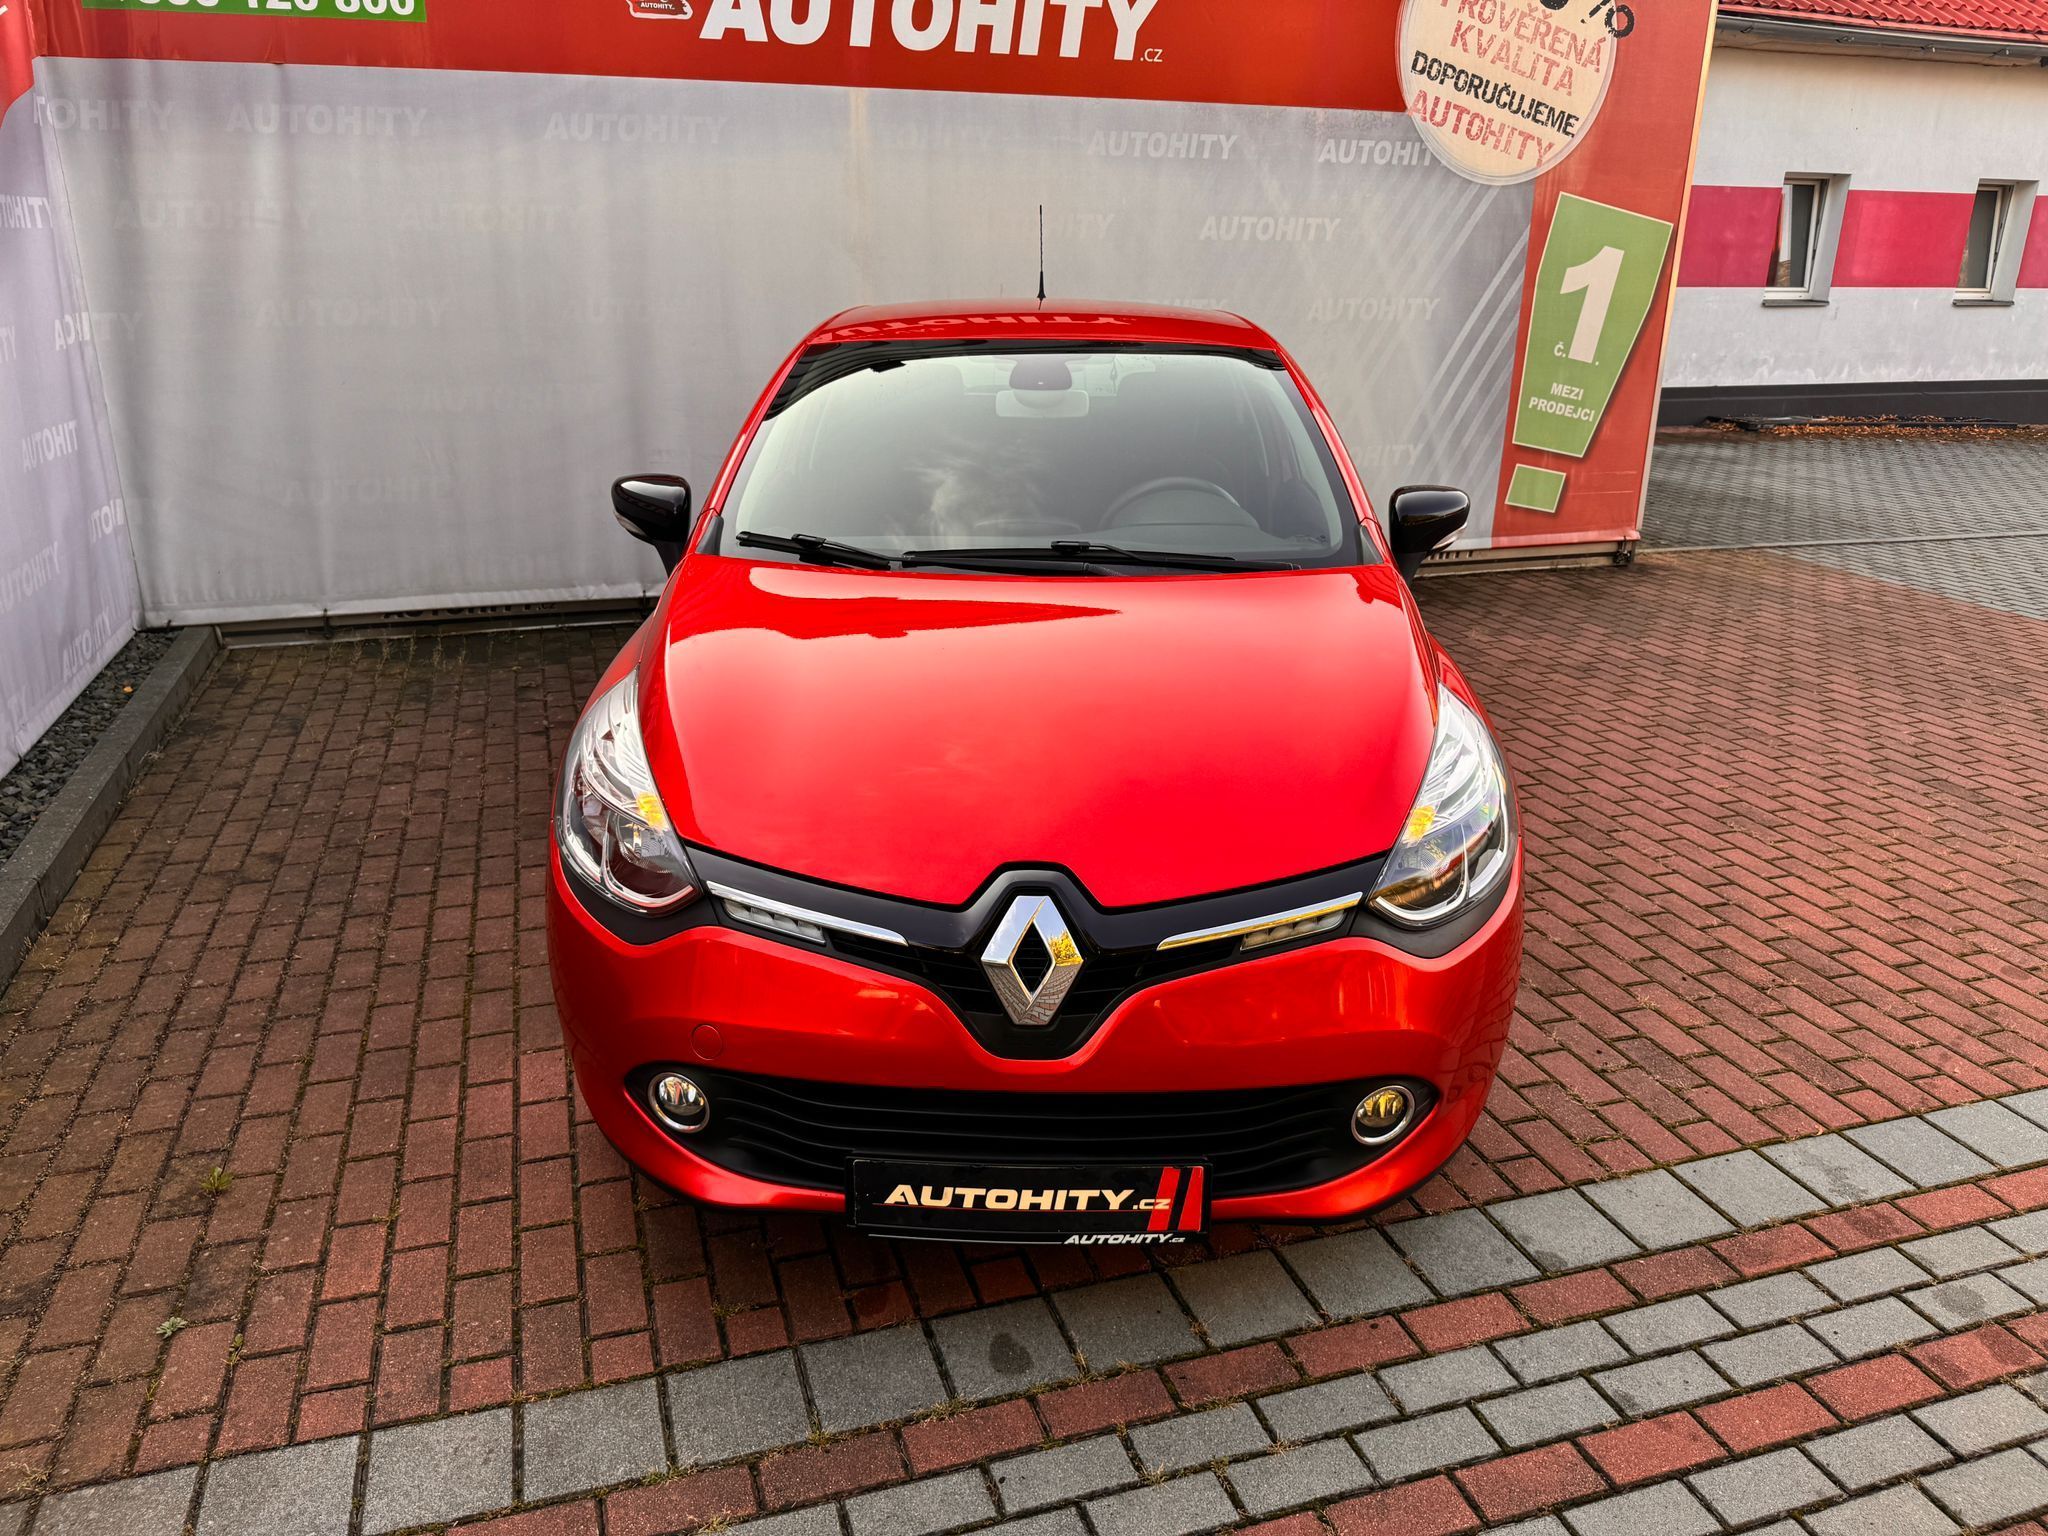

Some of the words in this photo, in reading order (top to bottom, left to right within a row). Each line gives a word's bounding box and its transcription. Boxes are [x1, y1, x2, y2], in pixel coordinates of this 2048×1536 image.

[1440, 0, 1606, 73] ROVĚŘENÁ
[1450, 20, 1574, 97] KVALITA
[1410, 50, 1580, 138] DOPORUČUJEME
[226, 104, 428, 137] AUTOHITY
[544, 112, 728, 144] AUTOHITY
[1408, 89, 1556, 168] AUTOHITY
[1087, 131, 1238, 160] AUTOHITY
[1318, 138, 1440, 166] AUTOHIT
[1200, 216, 1341, 242] AUTOHITY
[1308, 298, 1440, 322] AUTOHITY
[1550, 382, 1584, 401] MEZI
[1528, 396, 1595, 422] PRODEJCI
